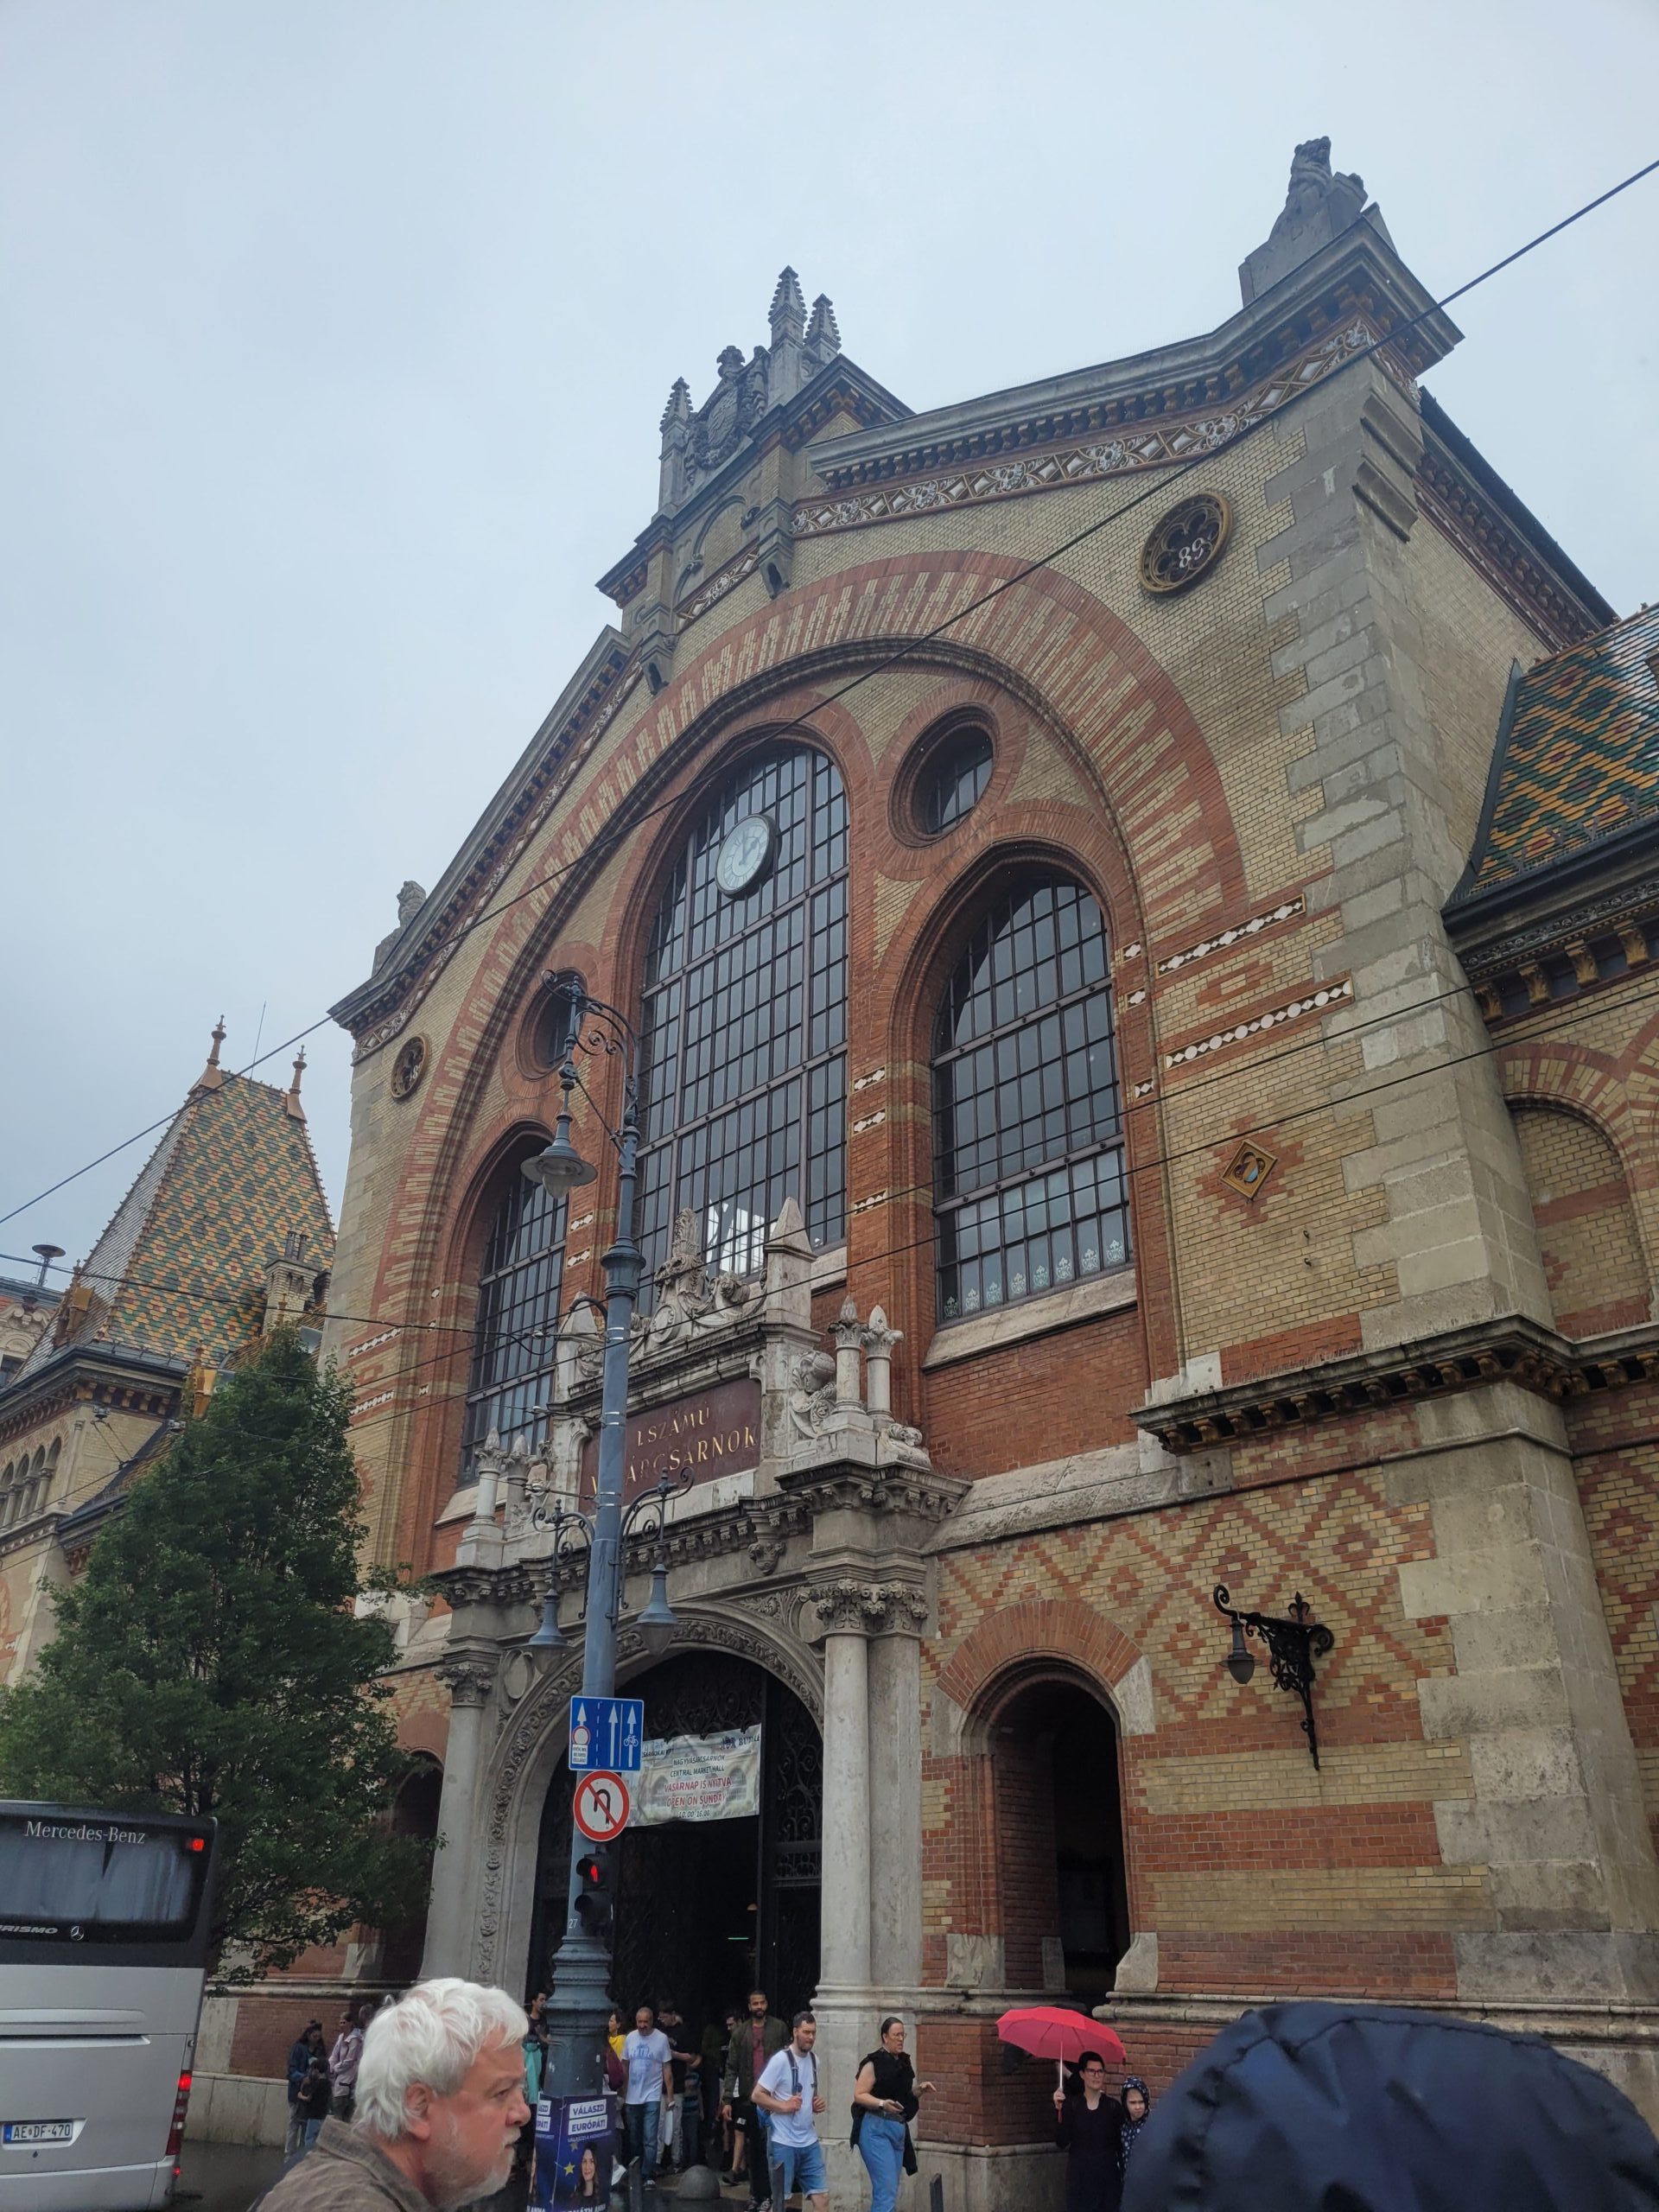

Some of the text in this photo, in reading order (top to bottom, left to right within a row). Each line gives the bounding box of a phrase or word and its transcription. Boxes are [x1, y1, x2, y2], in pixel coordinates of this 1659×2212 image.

[670, 1765, 725, 1777] CENTRAL MARKET HALL
[700, 1780, 707, 1789] IS
[708, 1778, 732, 1789] NYITVA
[666, 1793, 726, 1807] OPEN ON SUNDAY
[24, 1821, 146, 1844] Mercedes-Benz
[569, 1918, 578, 1929] 27
[0, 1925, 58, 1934] RISMO
[573, 2104, 604, 2115] VÁLASZD
